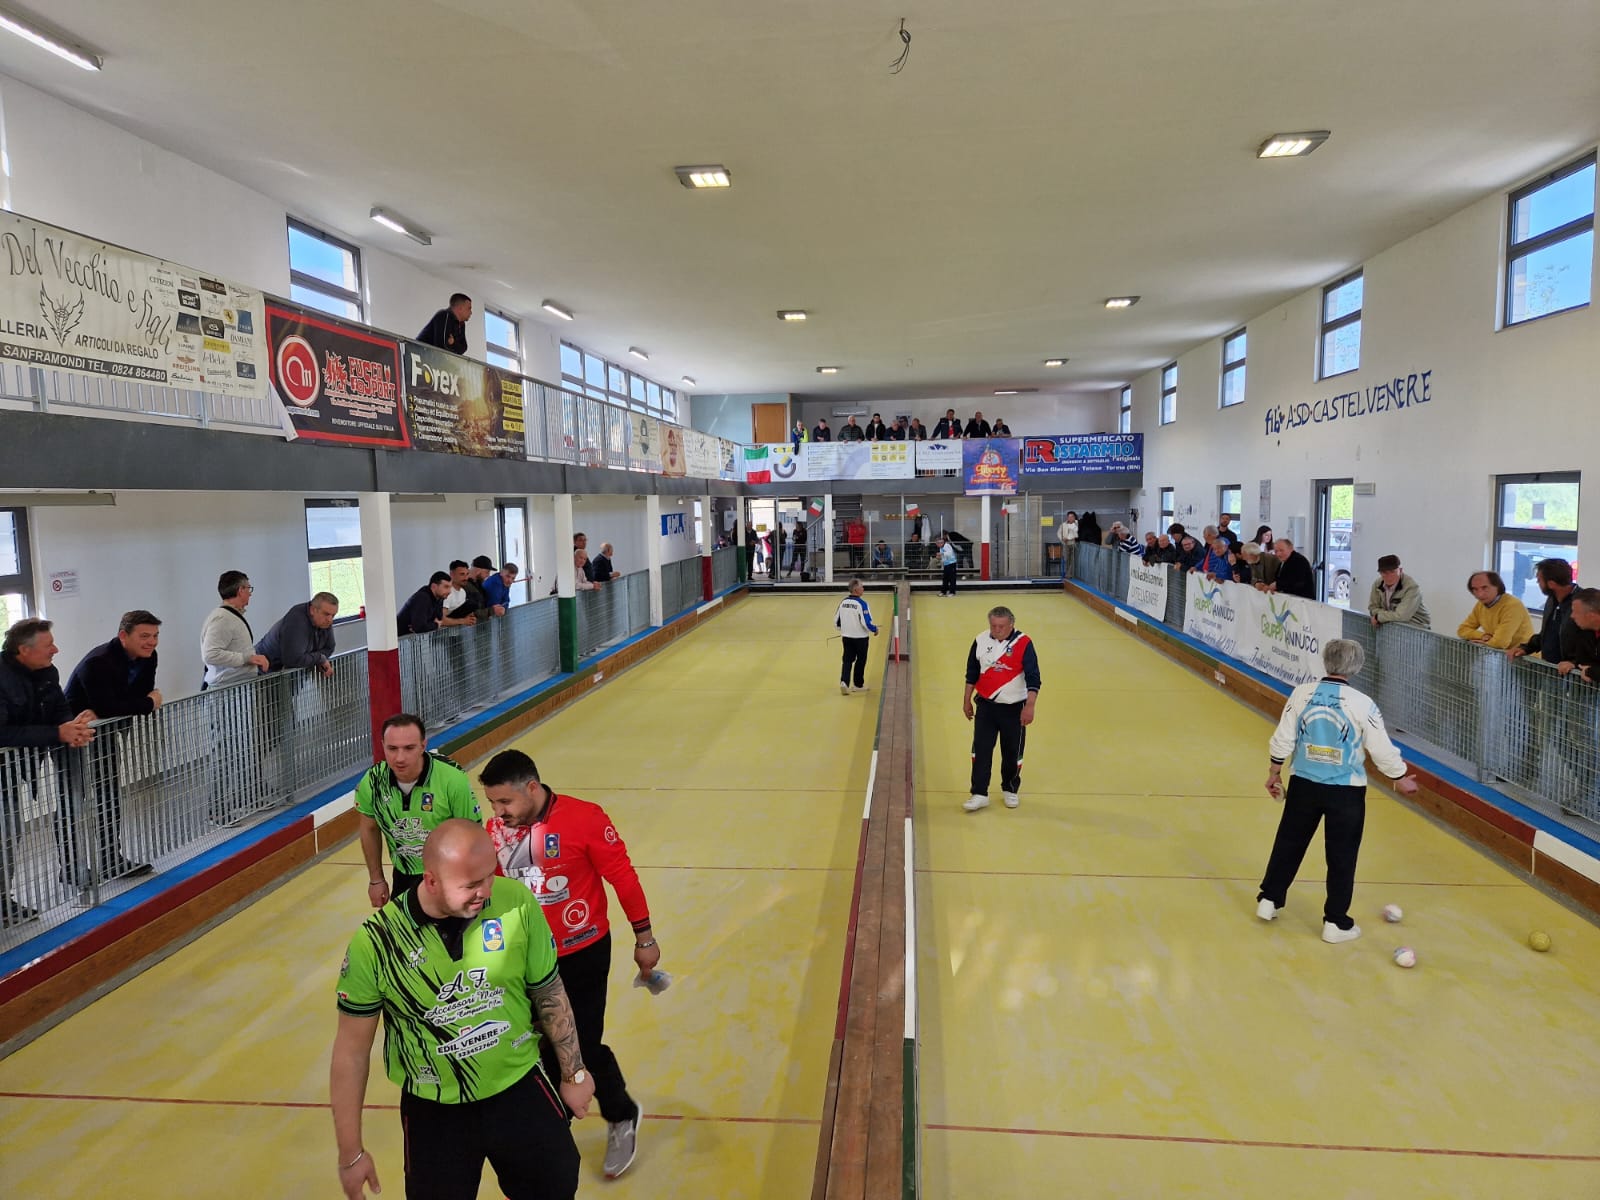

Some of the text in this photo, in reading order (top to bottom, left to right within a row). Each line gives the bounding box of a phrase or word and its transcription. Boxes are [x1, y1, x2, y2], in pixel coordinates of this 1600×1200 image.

[1, 227, 42, 275] Del
[44, 238, 122, 303] Vecchio
[75, 334, 158, 359] ARTICOLI DA REGALO
[3, 345, 166, 380] SANFRAMONDI TEL. 0824 864480
[411, 353, 460, 396] Forex
[1059, 434, 1135, 444] SUPERMERCATO
[438, 972, 469, 1000] A.
[425, 988, 504, 1018] Accessori Moda
[438, 1044, 459, 1053] EDIL
[460, 1028, 498, 1048] VENERE
